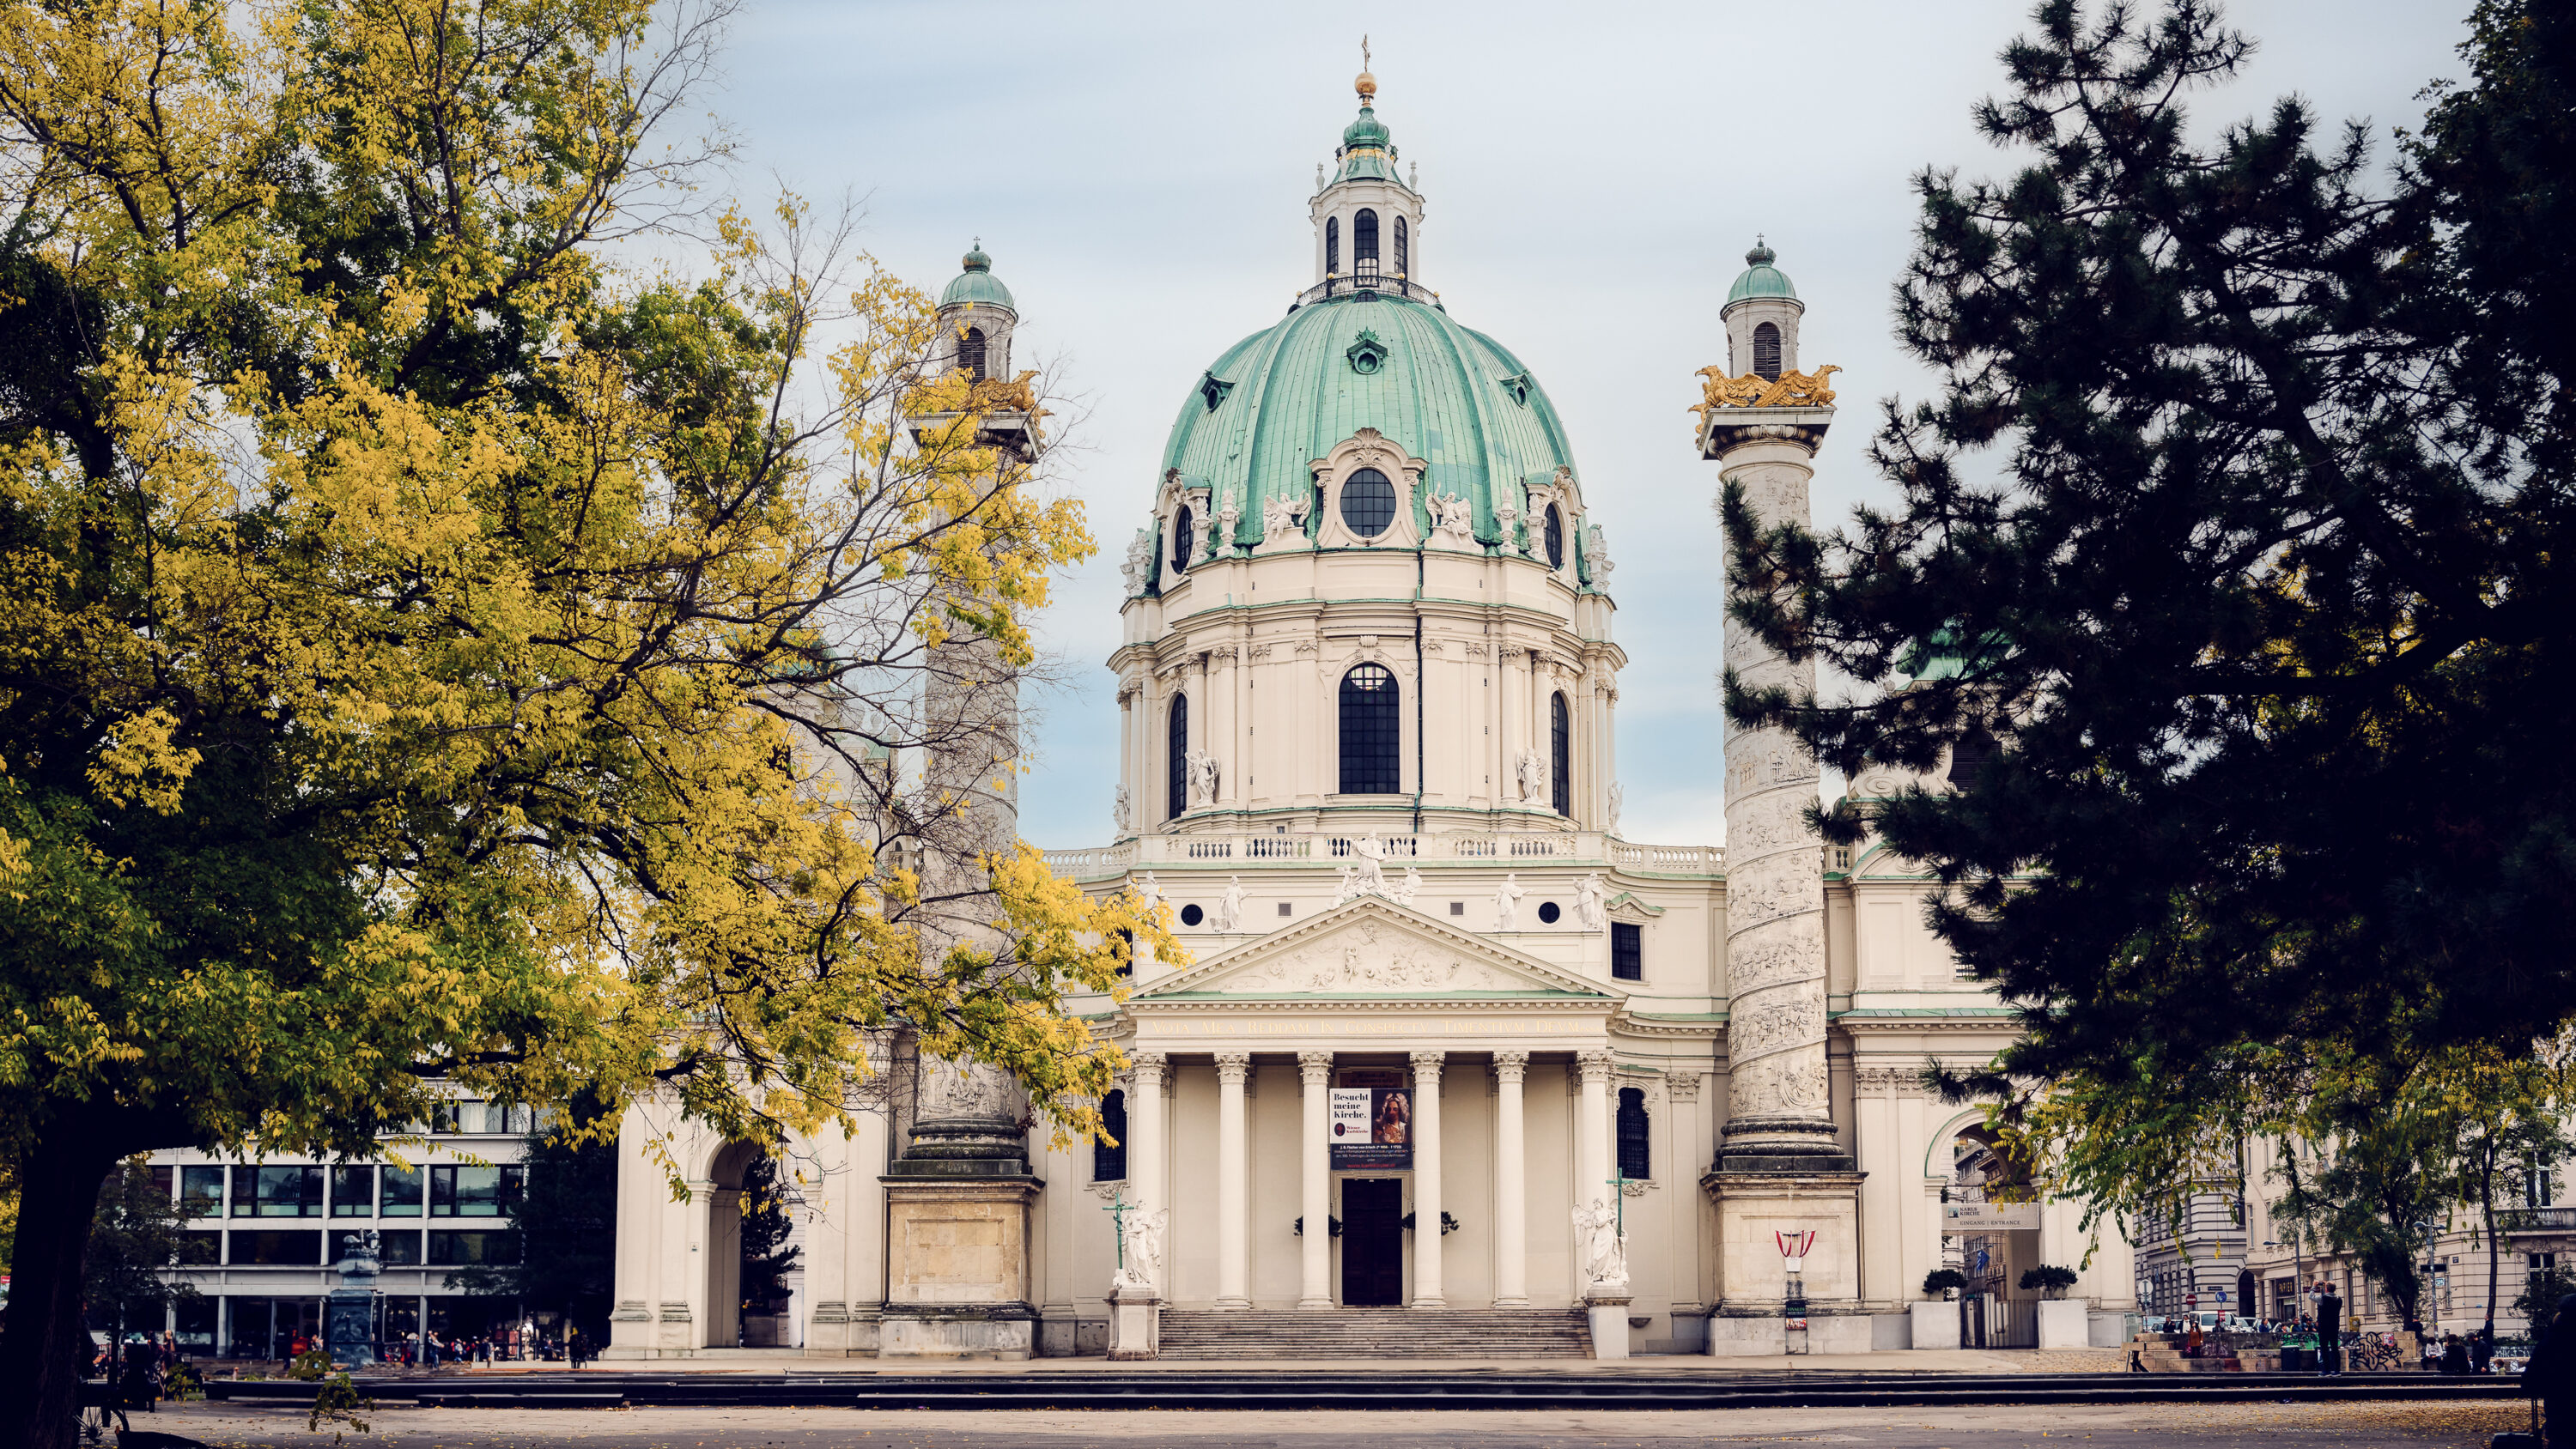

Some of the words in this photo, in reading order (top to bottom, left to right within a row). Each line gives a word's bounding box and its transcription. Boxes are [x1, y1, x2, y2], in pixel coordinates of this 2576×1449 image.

[1152, 1021, 1189, 1034] VOTA
[1202, 1021, 1235, 1034] MEA
[1248, 1021, 1309, 1034] REDDAM
